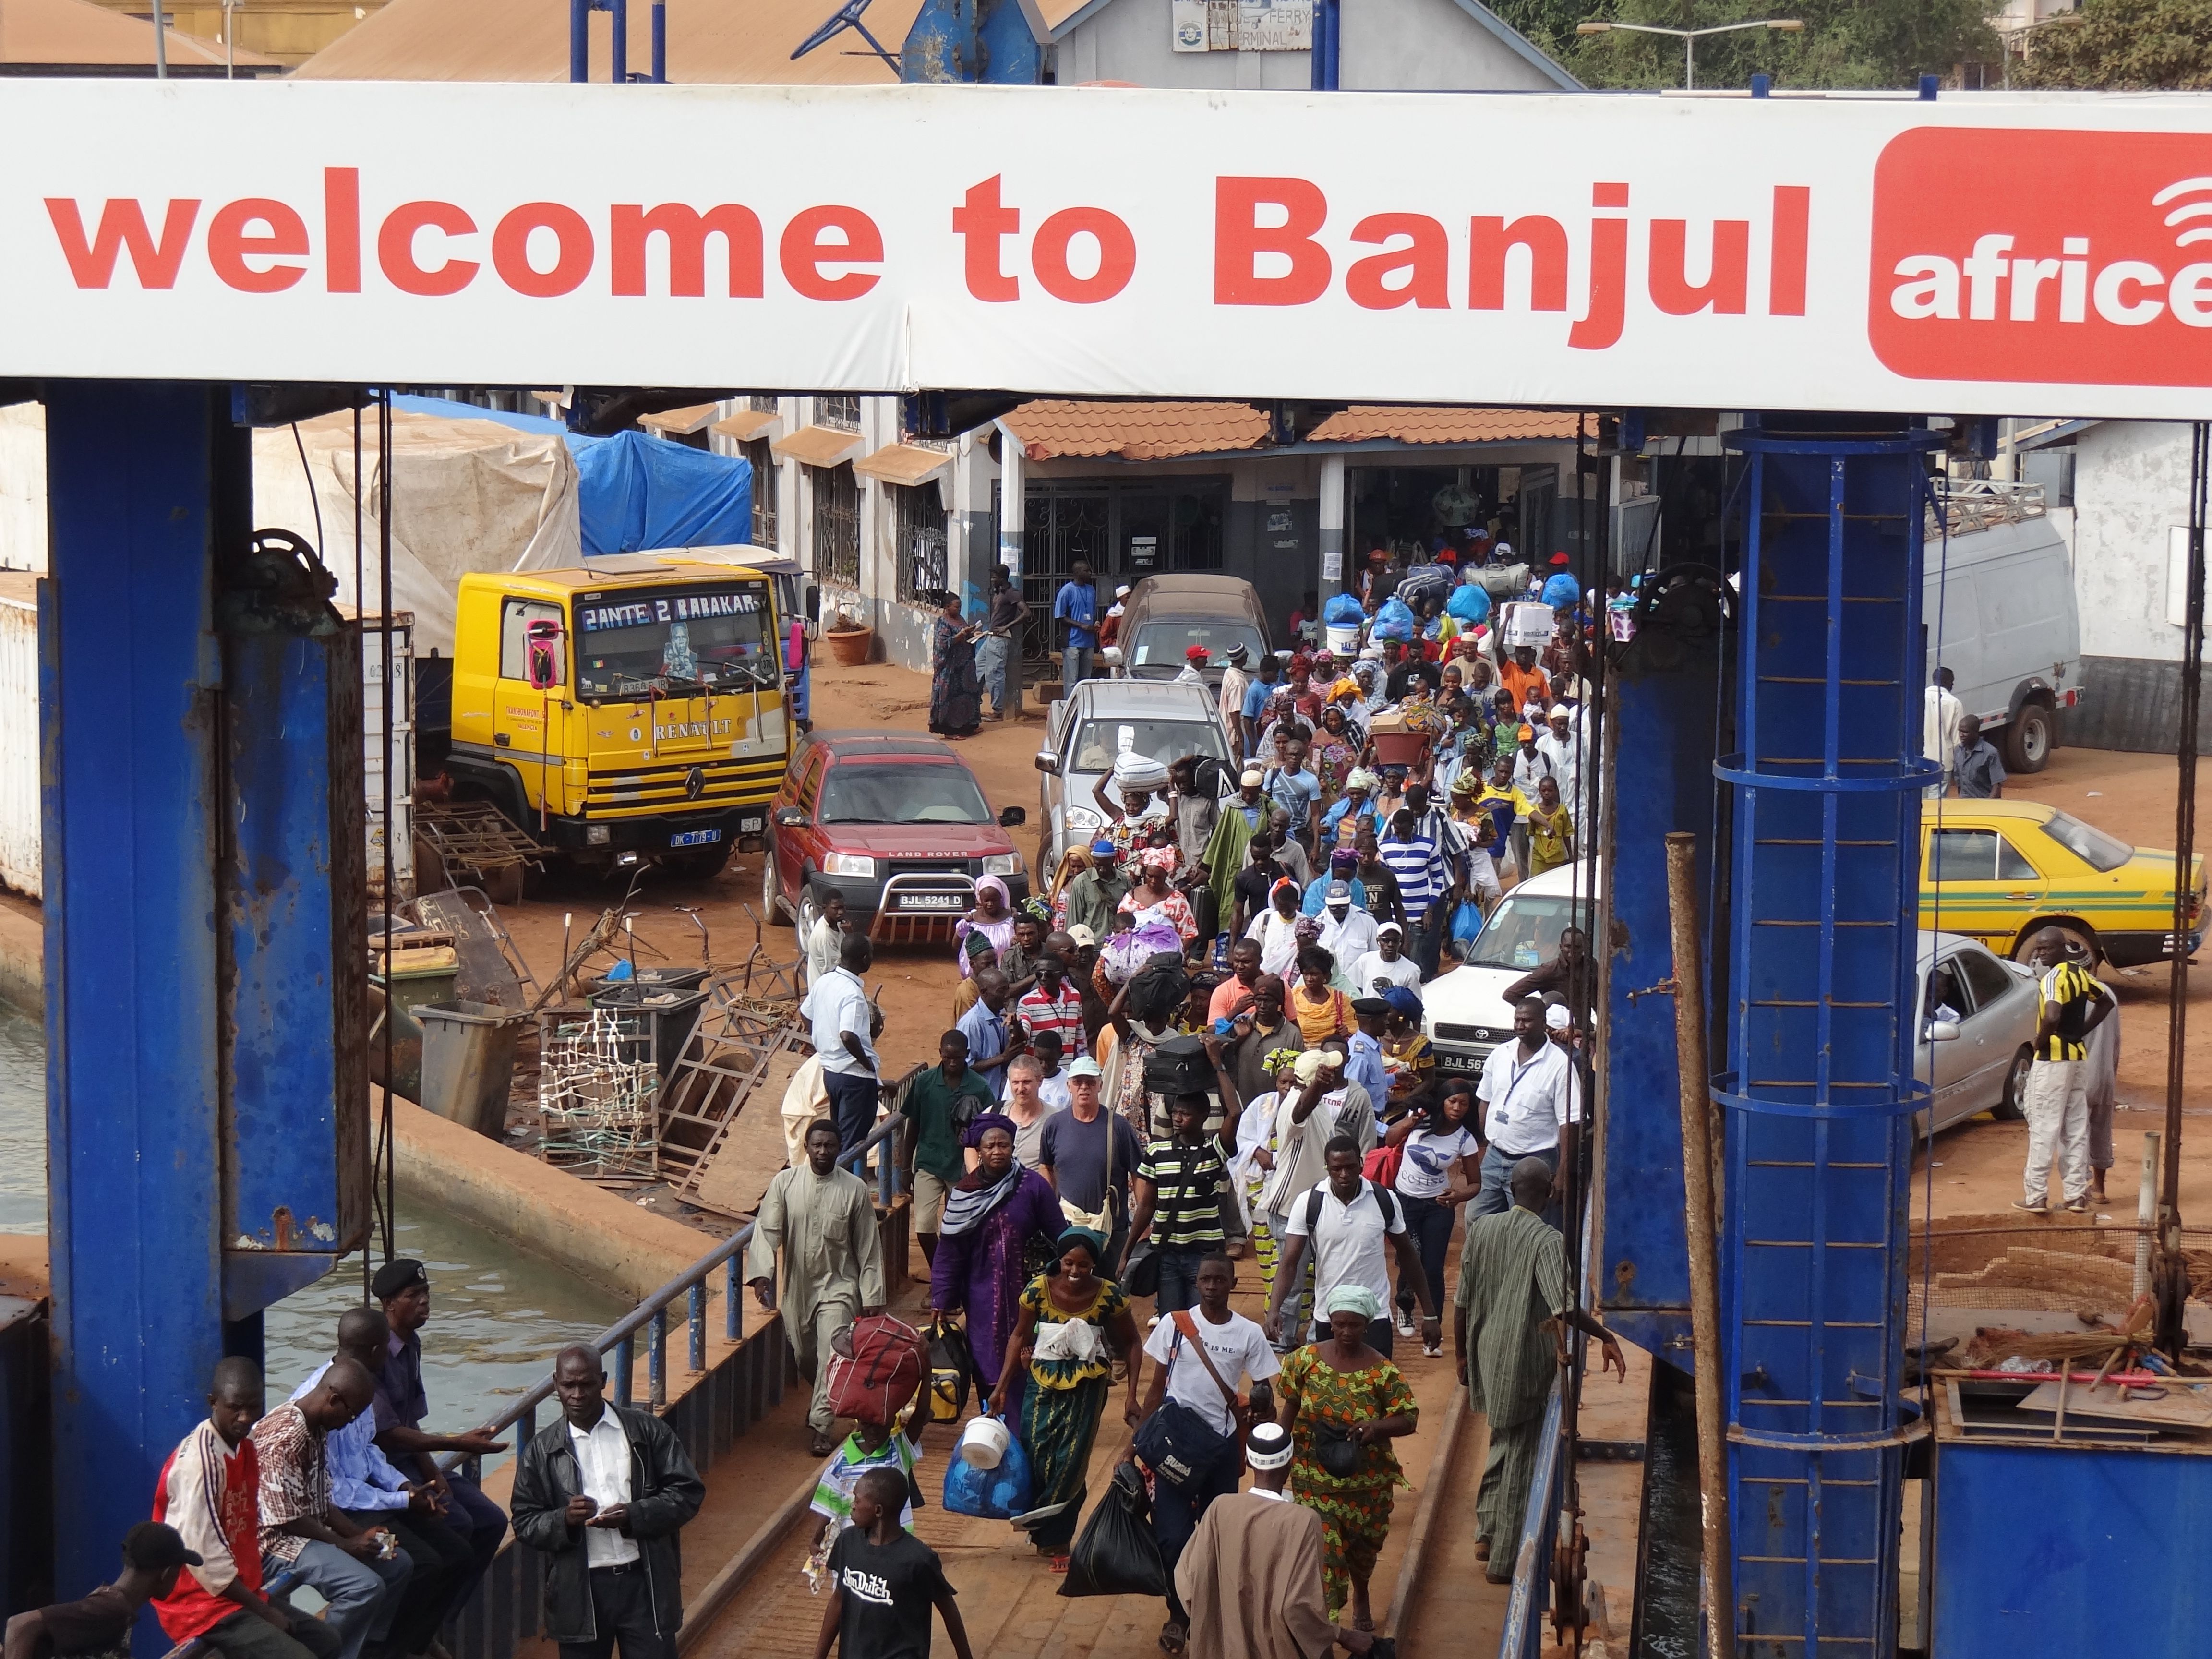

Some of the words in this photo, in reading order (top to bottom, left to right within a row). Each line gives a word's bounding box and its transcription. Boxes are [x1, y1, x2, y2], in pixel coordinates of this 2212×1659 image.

[1269, 9, 1310, 24] FERRY
[45, 167, 883, 302] welcome
[953, 174, 1136, 303] to
[1215, 176, 1810, 350] Banjul
[657, 600, 671, 622] 2
[677, 594, 755, 620] BABAKAR
[656, 719, 731, 740] RENAULT
[744, 819, 759, 830] SP
[901, 896, 921, 905] BJL
[925, 896, 950, 905] 5241
[953, 896, 961, 904] D
[1444, 1057, 1465, 1068] BJL
